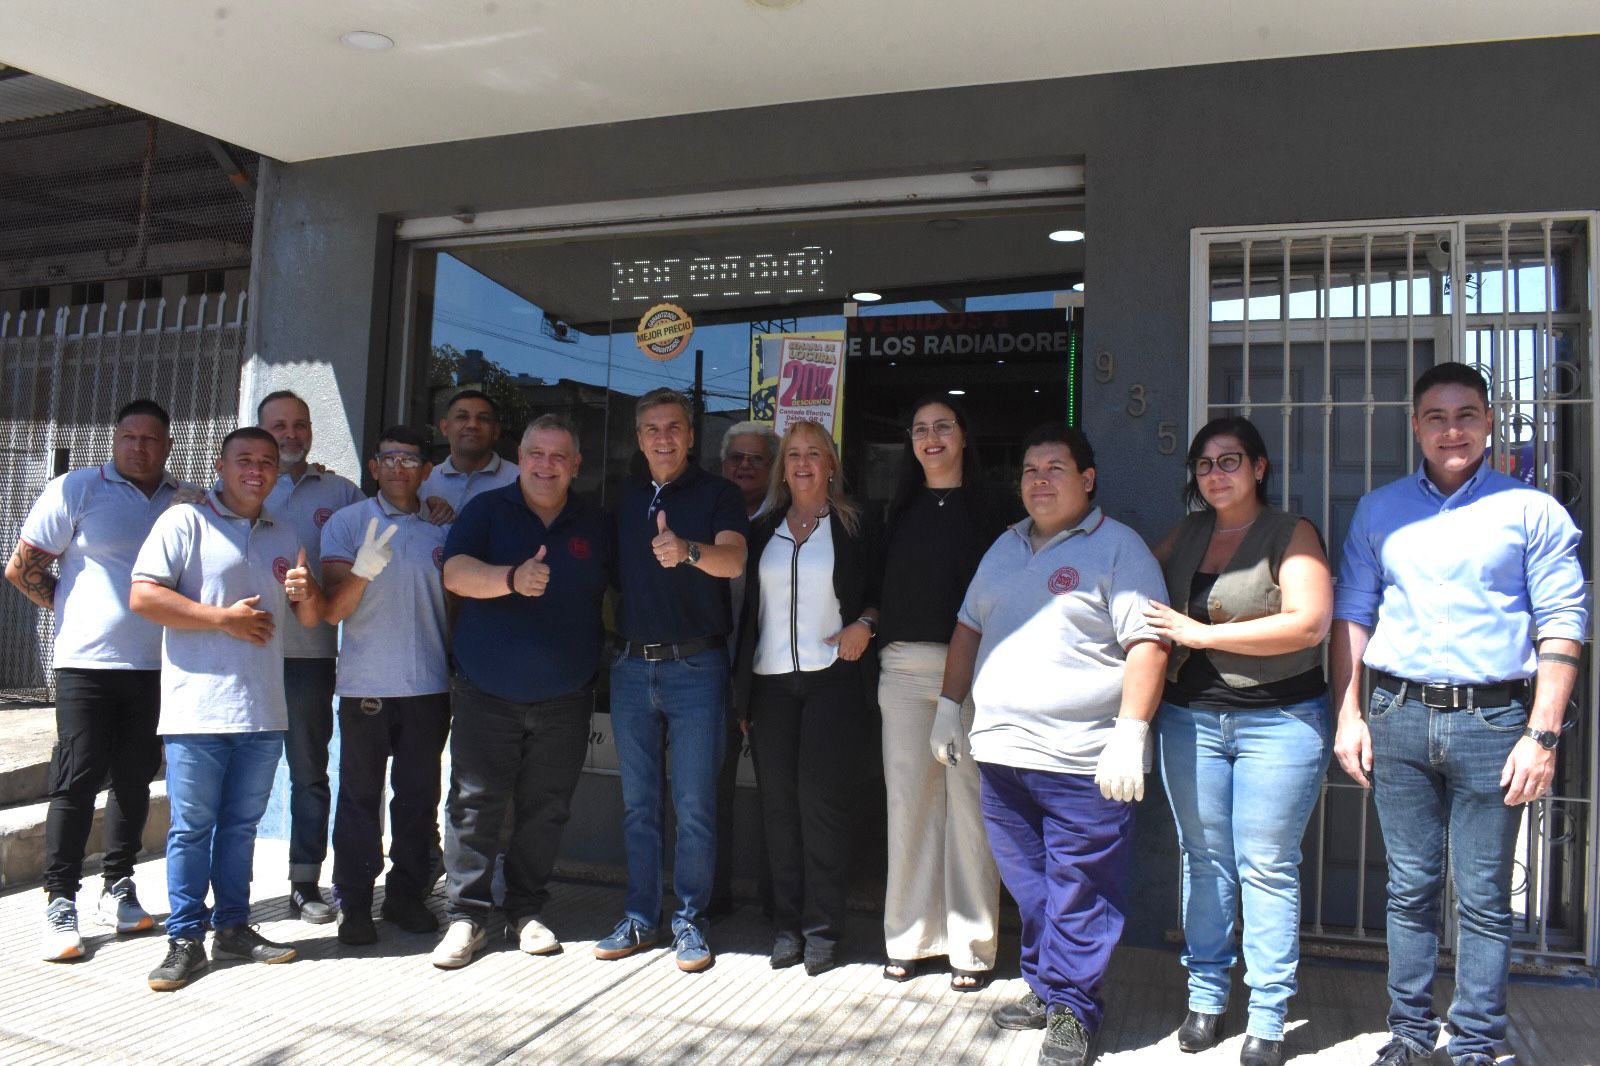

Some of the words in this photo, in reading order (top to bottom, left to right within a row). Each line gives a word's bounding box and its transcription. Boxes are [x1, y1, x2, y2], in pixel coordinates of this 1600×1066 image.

[637, 329, 662, 343] MEJOR
[664, 321, 691, 335] PRECIO
[789, 342, 822, 351] SEMANA
[824, 343, 836, 352] DE
[869, 335, 916, 356] LOS
[789, 350, 836, 365] LOCURA
[780, 360, 835, 406] 20%
[792, 399, 832, 407] DESCUENTO
